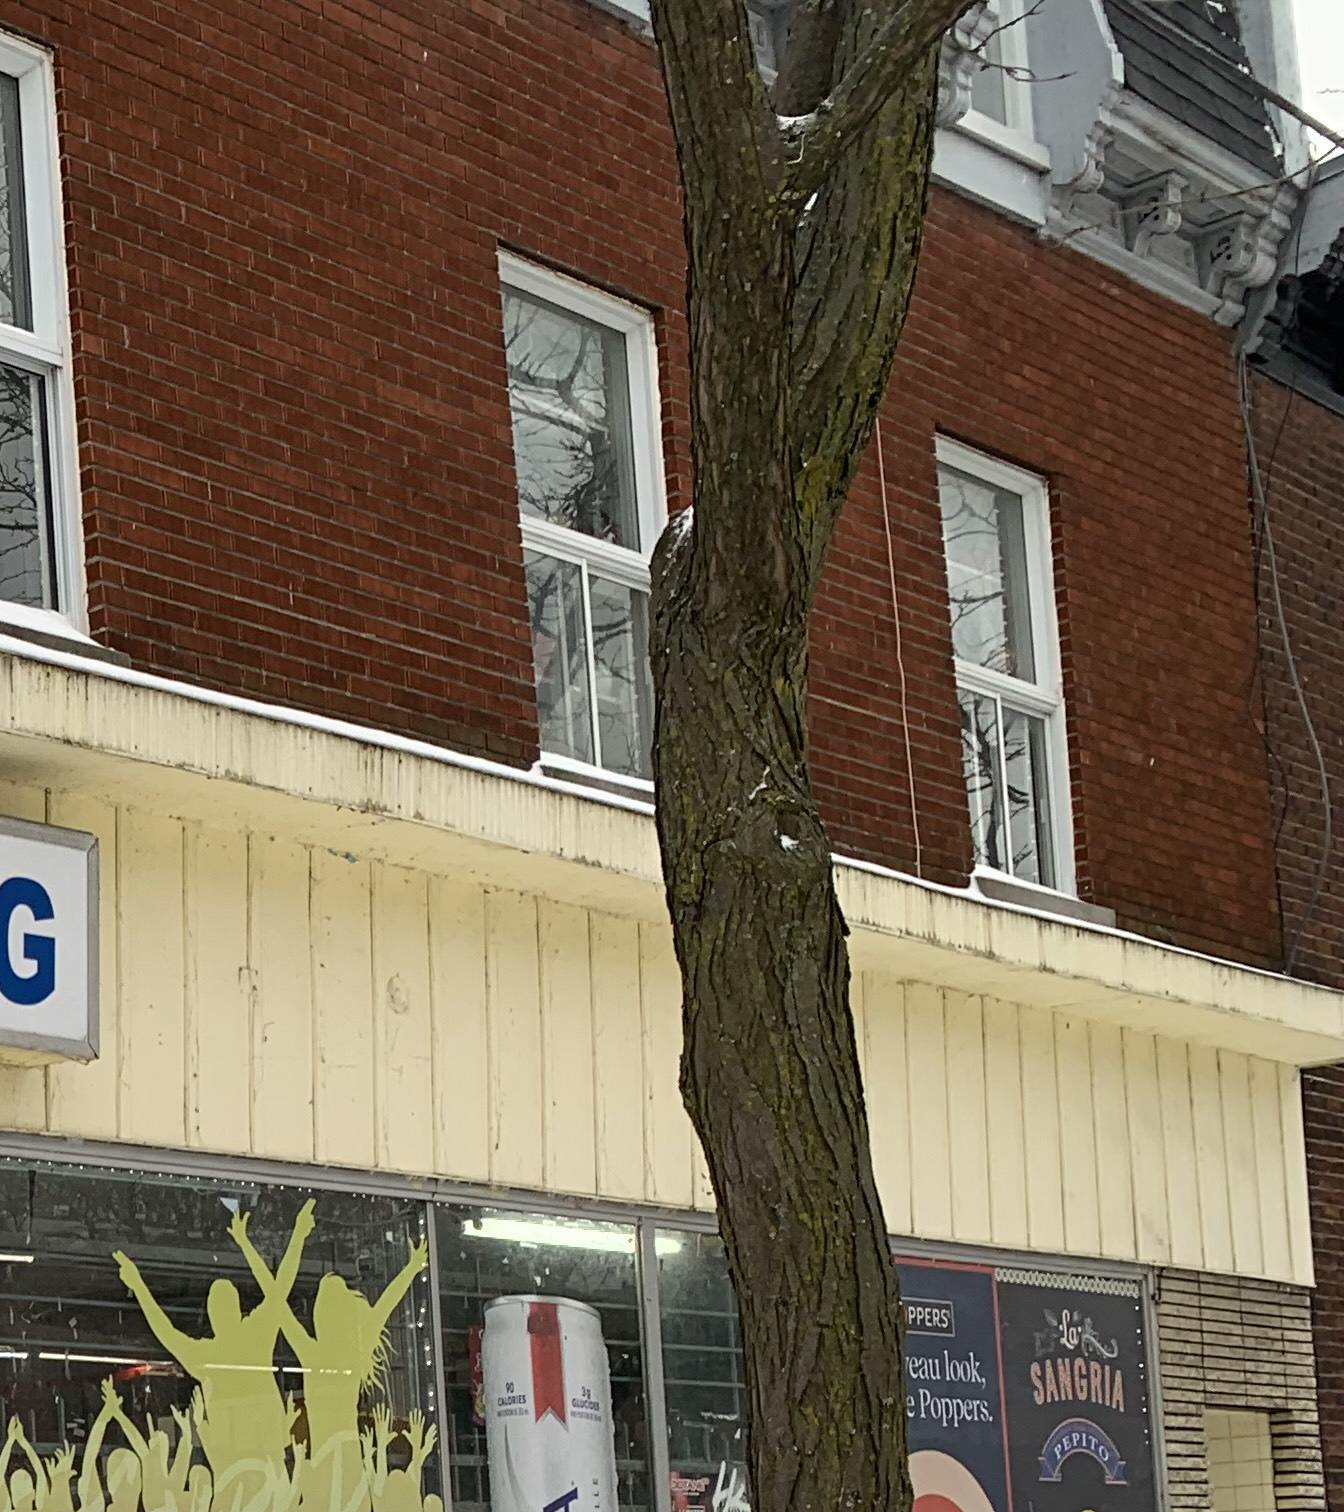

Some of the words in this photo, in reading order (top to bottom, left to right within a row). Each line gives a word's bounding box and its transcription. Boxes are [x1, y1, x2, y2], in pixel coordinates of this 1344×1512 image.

[904, 1305, 949, 1329] PPERS
[1058, 1308, 1082, 1350] La
[943, 1349, 987, 1390] look,
[1029, 1356, 1126, 1413] SANGRIA
[497, 1394, 527, 1407] CALORIES
[918, 1387, 994, 1428] Poppers.
[1053, 1432, 1110, 1463] PEPITO
